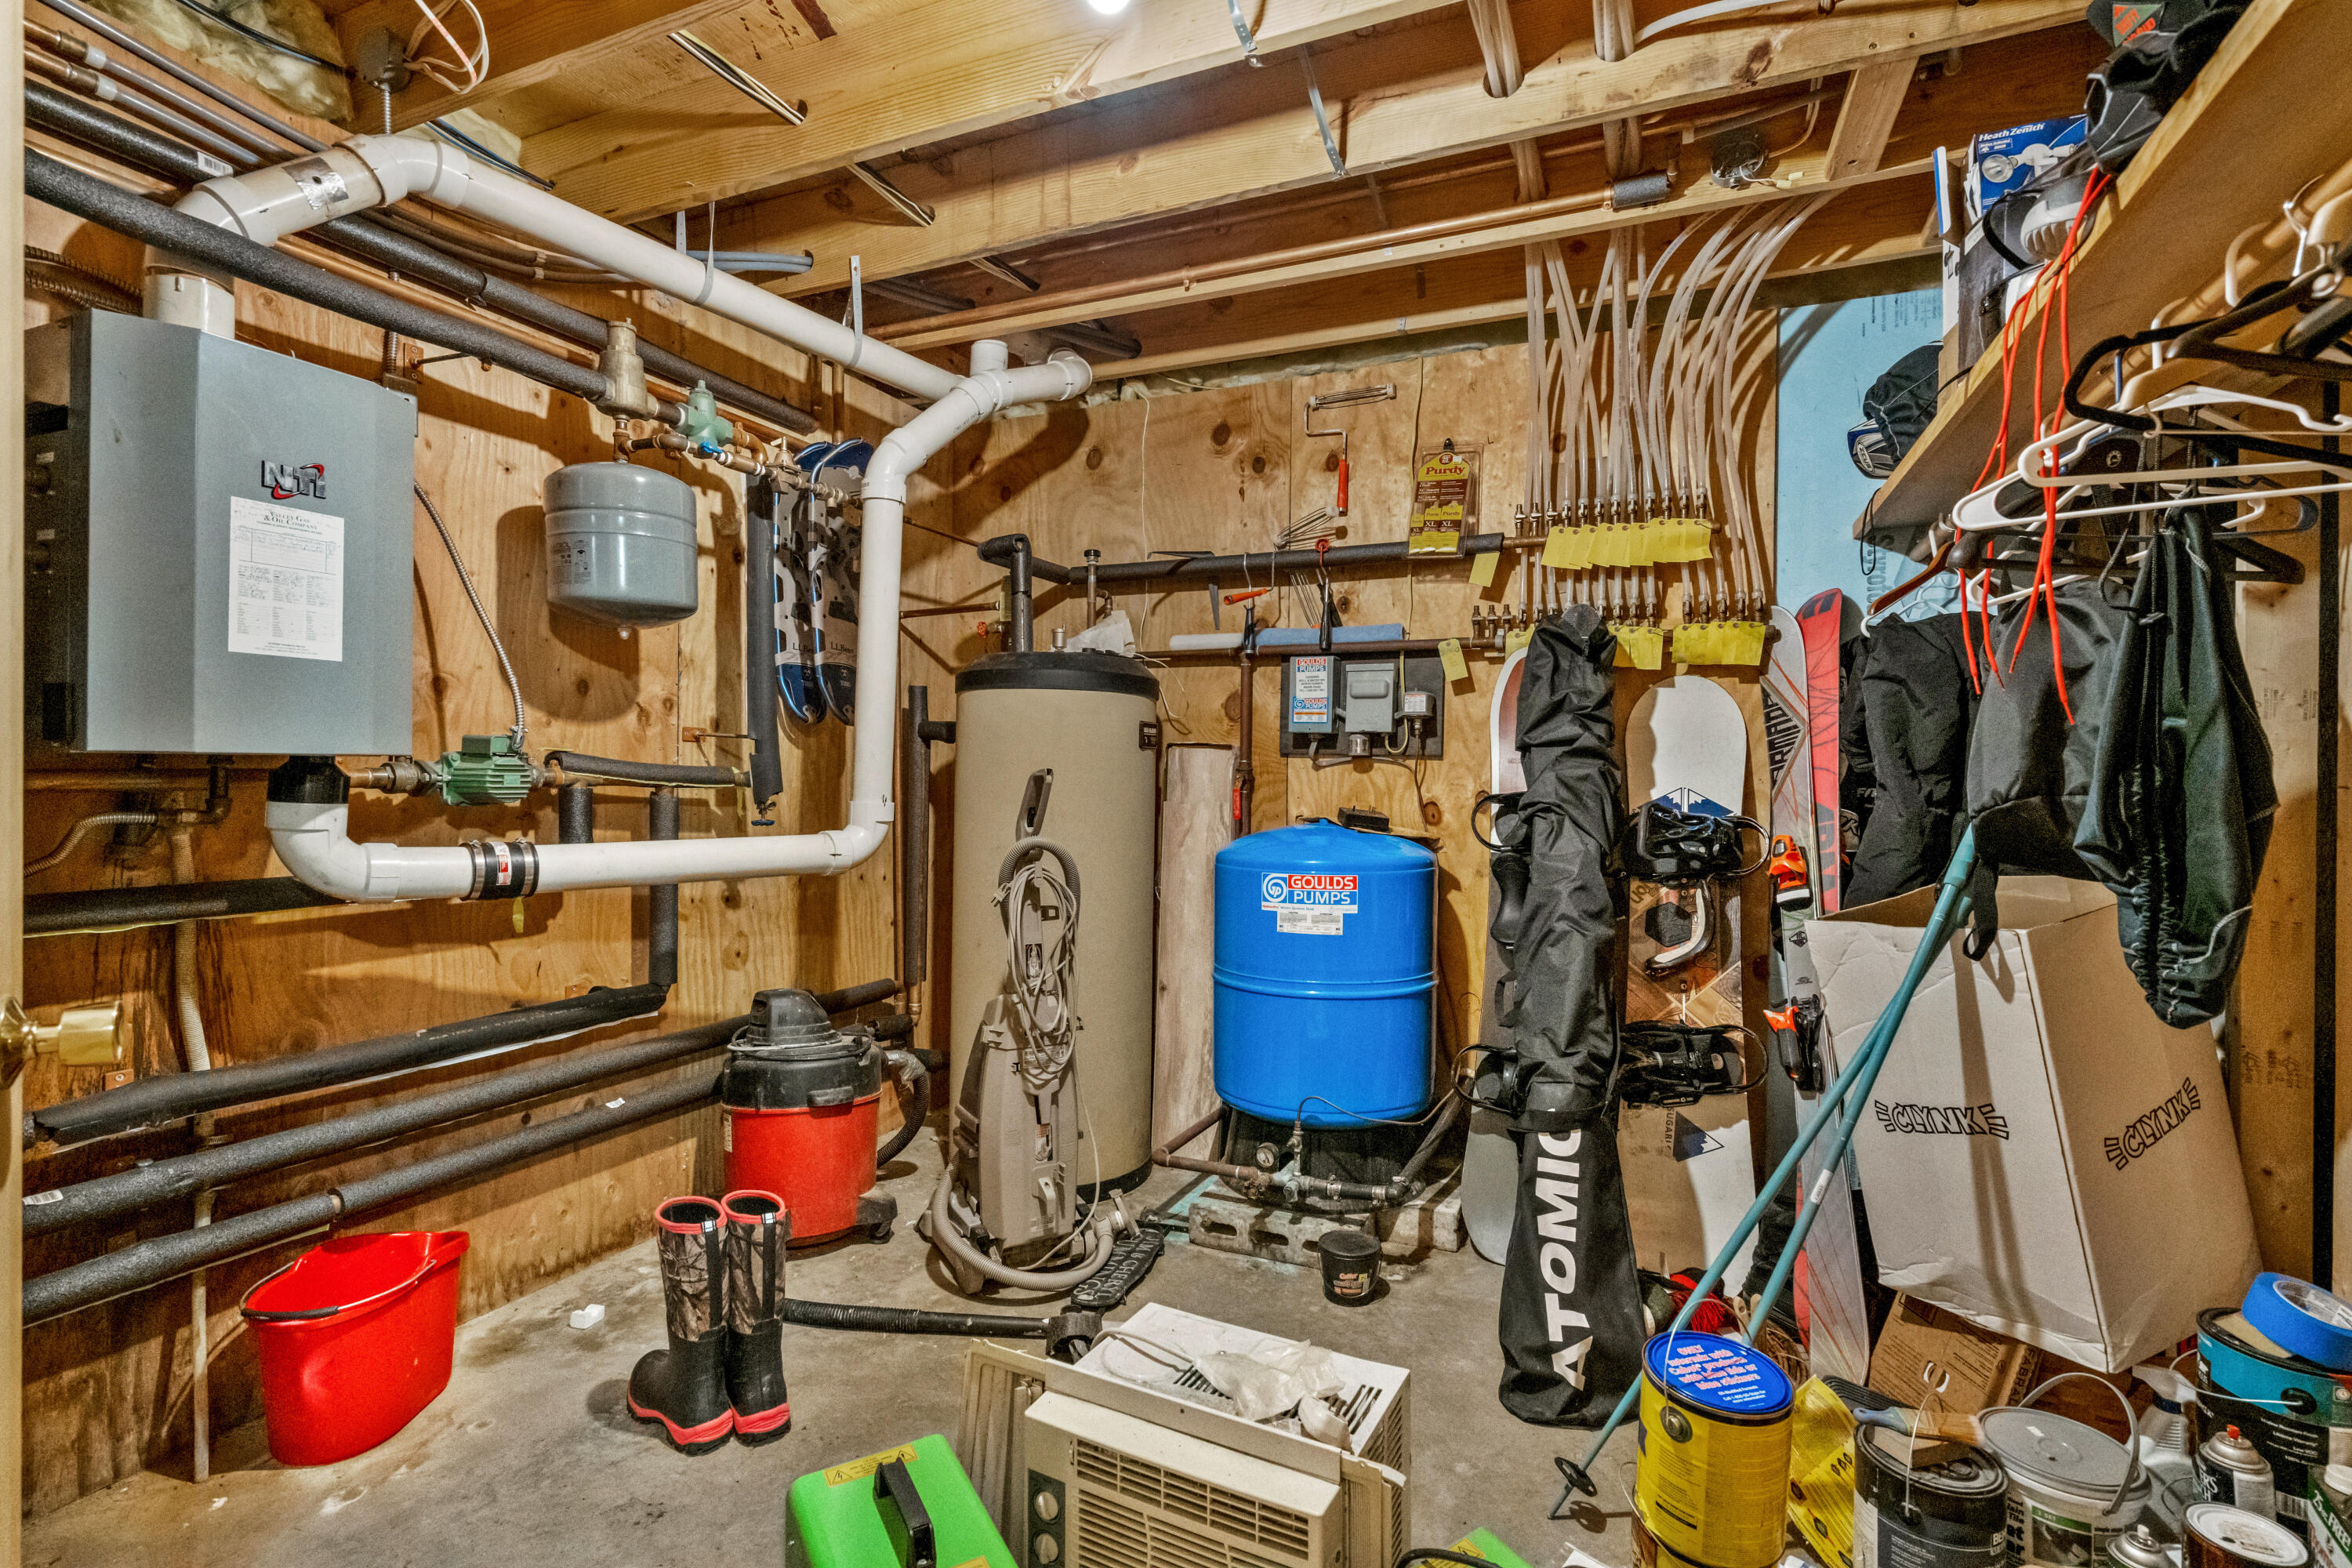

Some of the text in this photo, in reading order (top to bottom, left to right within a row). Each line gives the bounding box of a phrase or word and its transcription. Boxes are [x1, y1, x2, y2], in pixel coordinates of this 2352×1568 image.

[1979, 123, 2045, 142] Heath Zenith
[1425, 465, 1465, 475] Purdy
[261, 460, 326, 499] NTI
[270, 510, 310, 524] VALLEY GAS
[286, 519, 318, 531] COMPANY
[1290, 876, 1354, 889] GOULDS
[1294, 891, 1350, 904] PUMPS
[1892, 1102, 1987, 1135] CLYNK
[2123, 1088, 2191, 1158] CLYNK
[1535, 1128, 1593, 1392] ATOMIC
[1096, 1261, 1138, 1299] CHERYL
[1708, 1348, 1734, 1359] with
[1702, 1356, 1748, 1373] products
[1720, 1373, 1762, 1386] stickers
[2007, 1345, 2034, 1406] FABRAL
